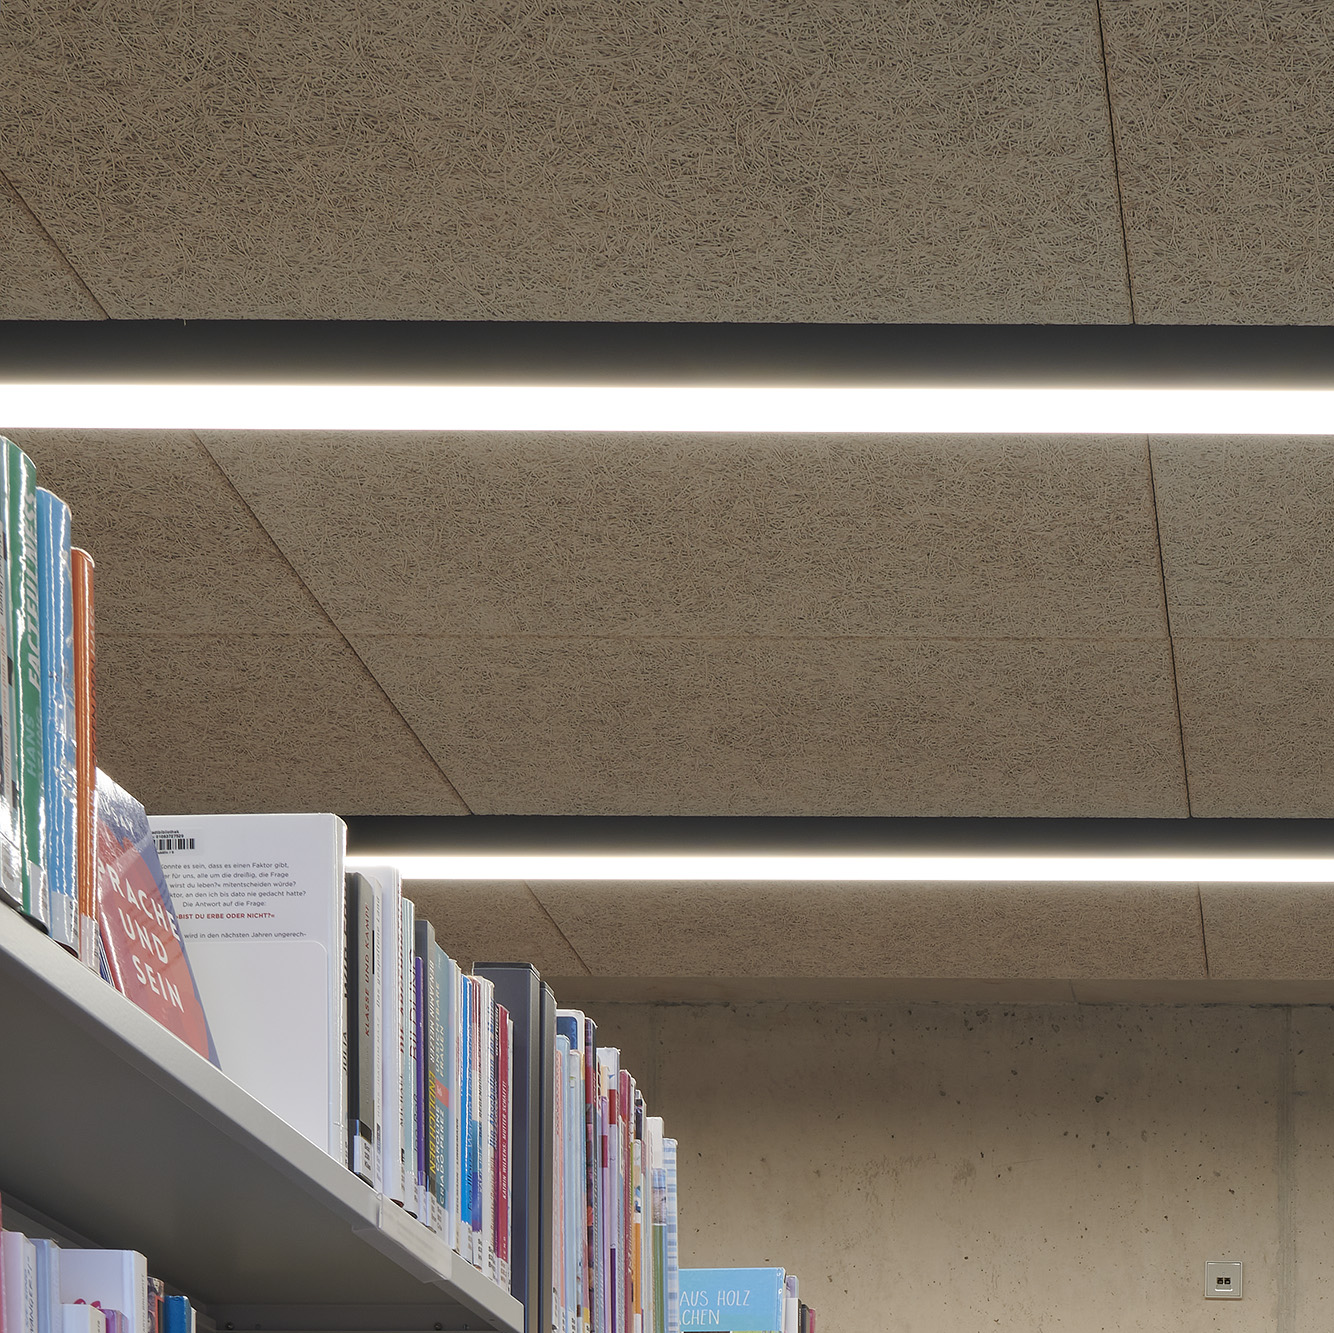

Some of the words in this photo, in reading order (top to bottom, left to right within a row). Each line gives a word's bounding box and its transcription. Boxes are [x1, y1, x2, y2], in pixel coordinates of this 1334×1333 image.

[118, 906, 169, 965] UND
[132, 955, 185, 1015] SEIN
[680, 1290, 709, 1306] AUS
[717, 1289, 750, 1306] HOLZ
